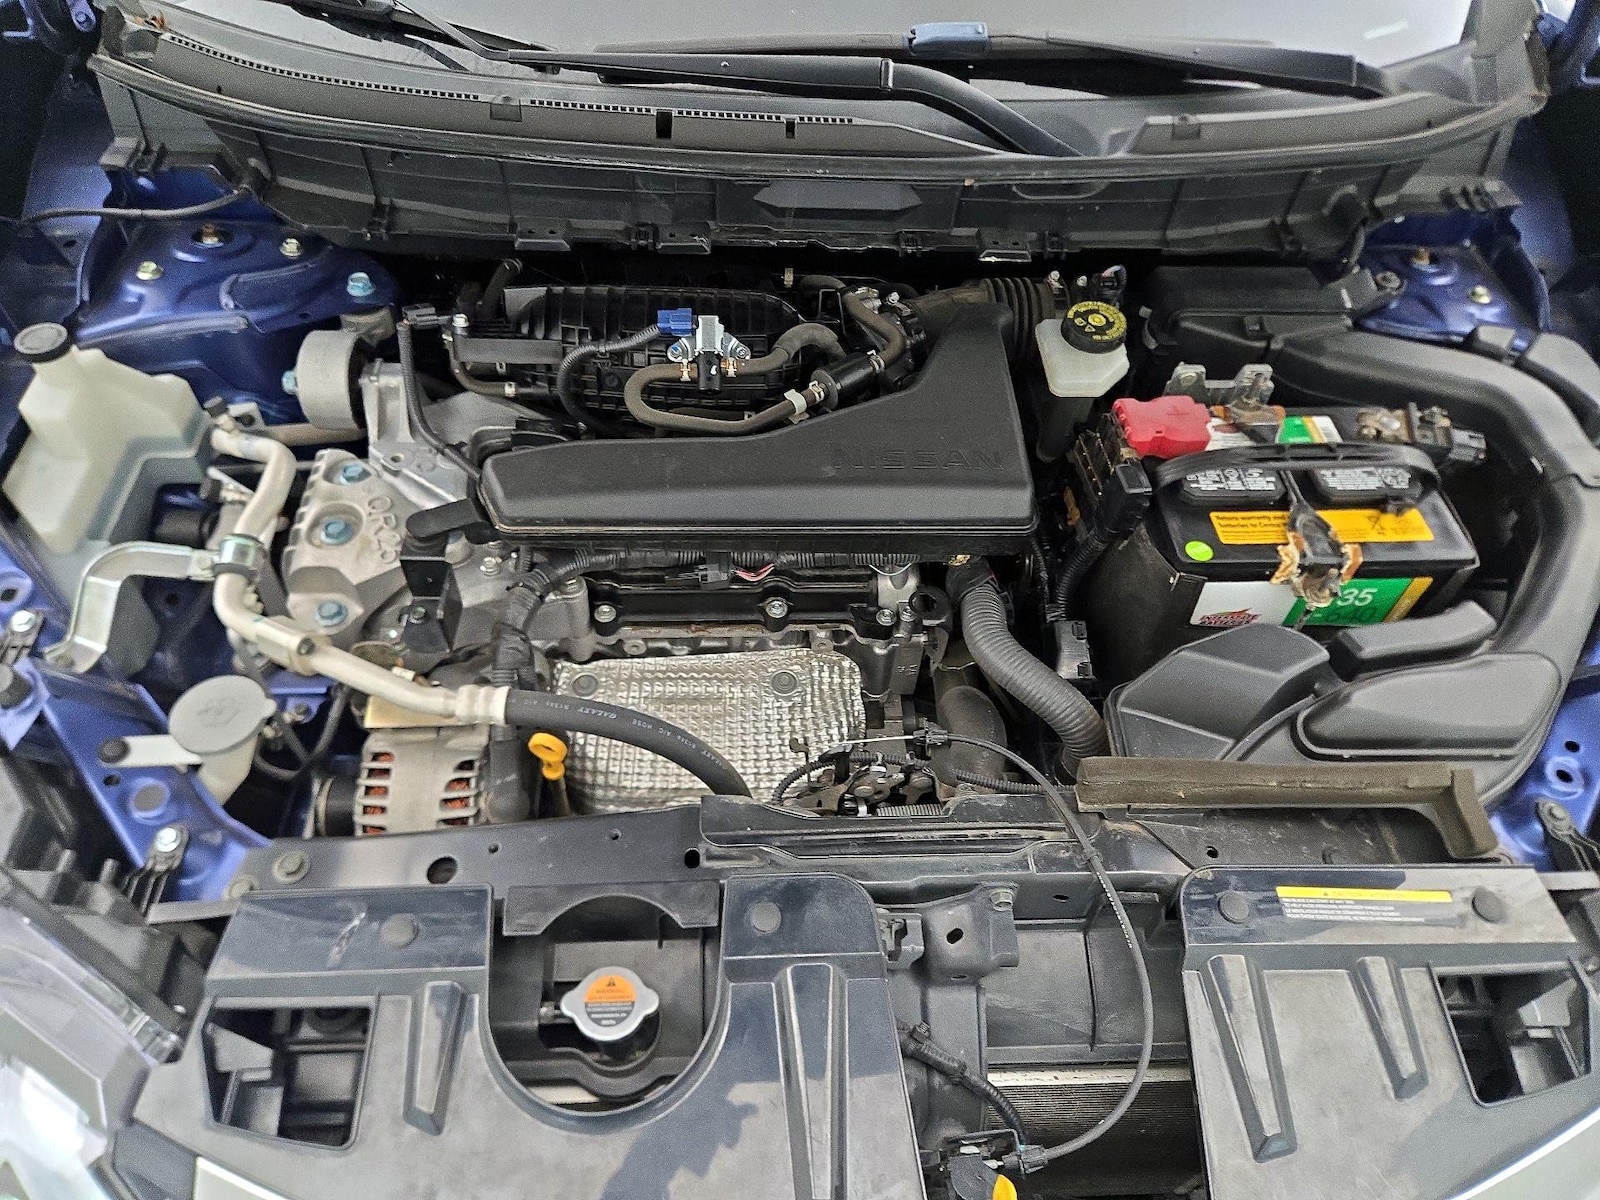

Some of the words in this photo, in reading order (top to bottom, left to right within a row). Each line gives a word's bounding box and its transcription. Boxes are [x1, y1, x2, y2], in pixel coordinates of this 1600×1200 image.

[834, 447, 1005, 470] NISSAN
[1336, 587, 1378, 606] 35
[577, 706, 617, 720] GALAXY
